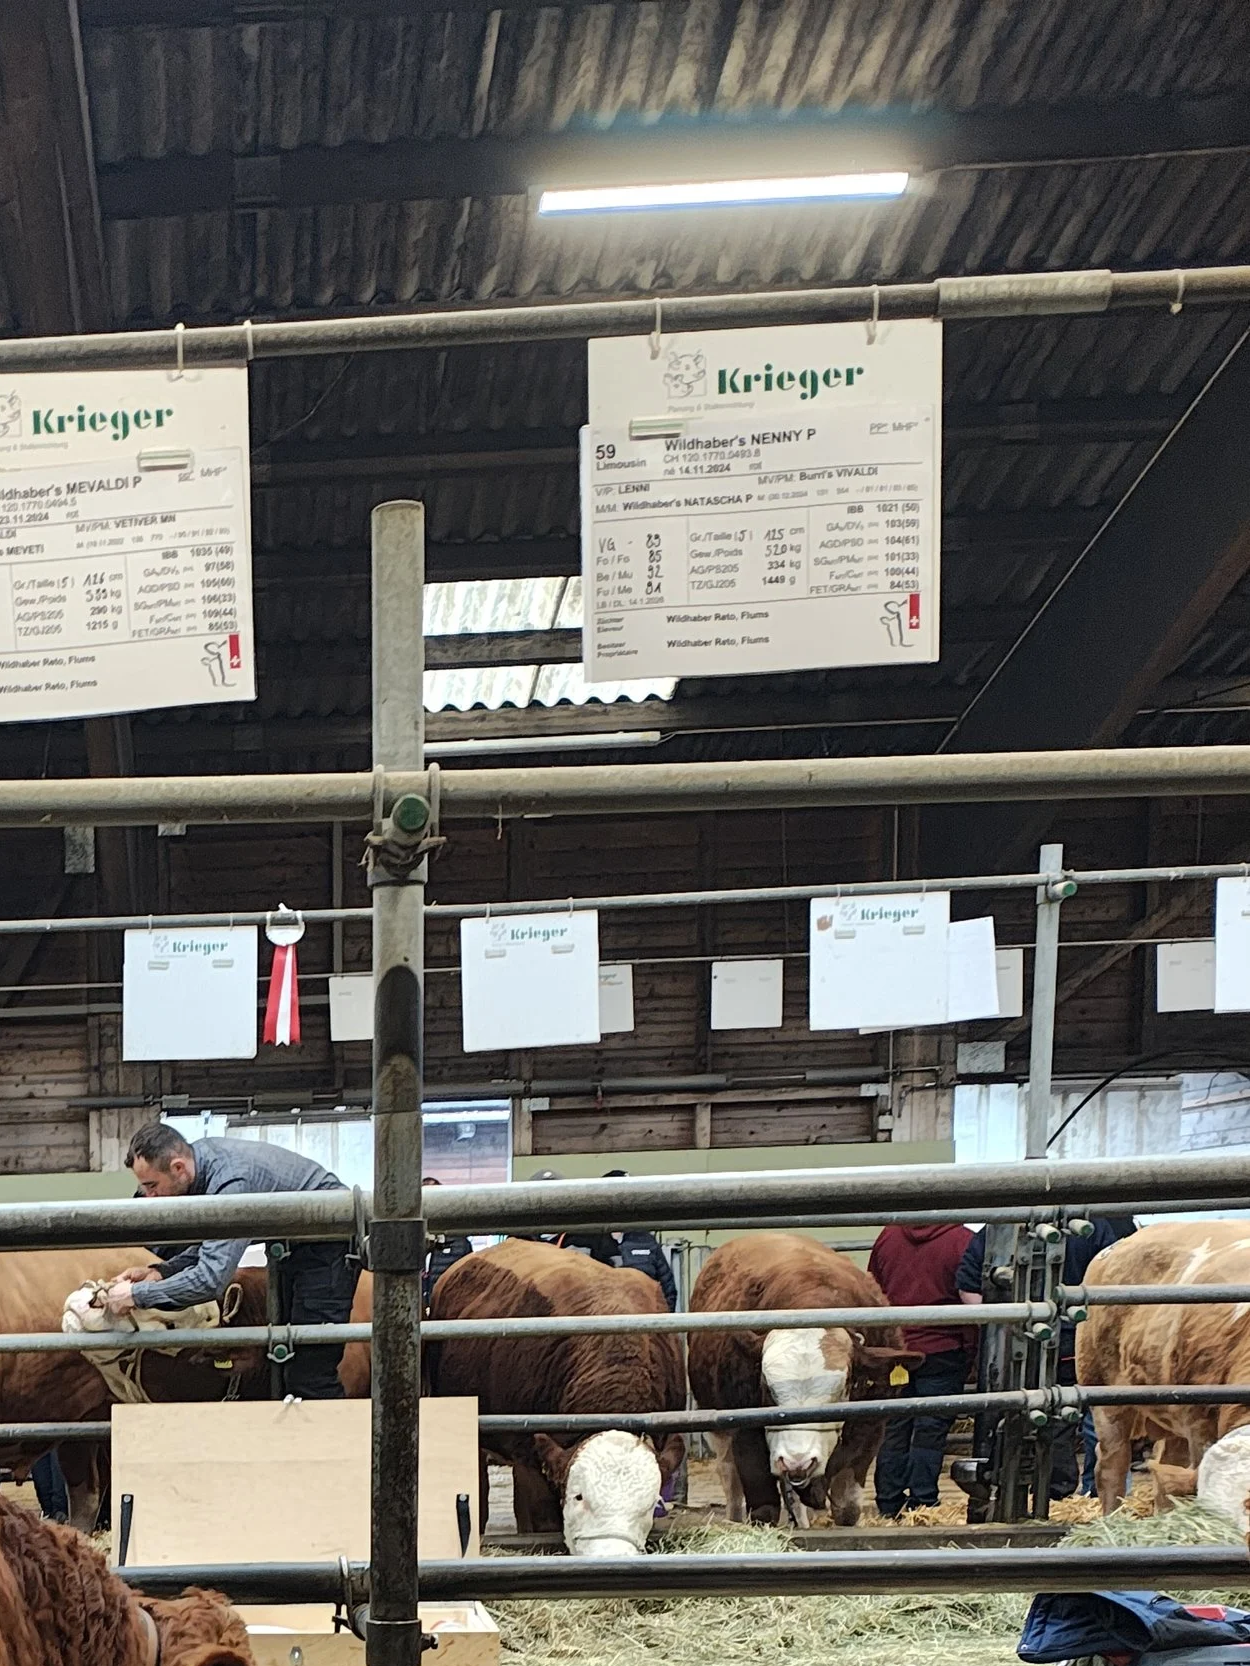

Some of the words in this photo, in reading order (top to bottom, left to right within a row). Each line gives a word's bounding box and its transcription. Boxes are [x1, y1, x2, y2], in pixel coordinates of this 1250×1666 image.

[718, 363, 864, 400] Krieger
[32, 404, 174, 441] Krieger
[664, 435, 746, 452] Wildhaber's
[750, 429, 803, 446] NENNY
[806, 428, 817, 441] P
[595, 444, 616, 460] 59
[596, 459, 647, 471] Limousin
[66, 477, 130, 495] MEVALDI
[131, 475, 142, 489] P
[861, 906, 919, 923] Krieger
[510, 926, 568, 942] Krieger
[172, 939, 228, 955] Krieger
